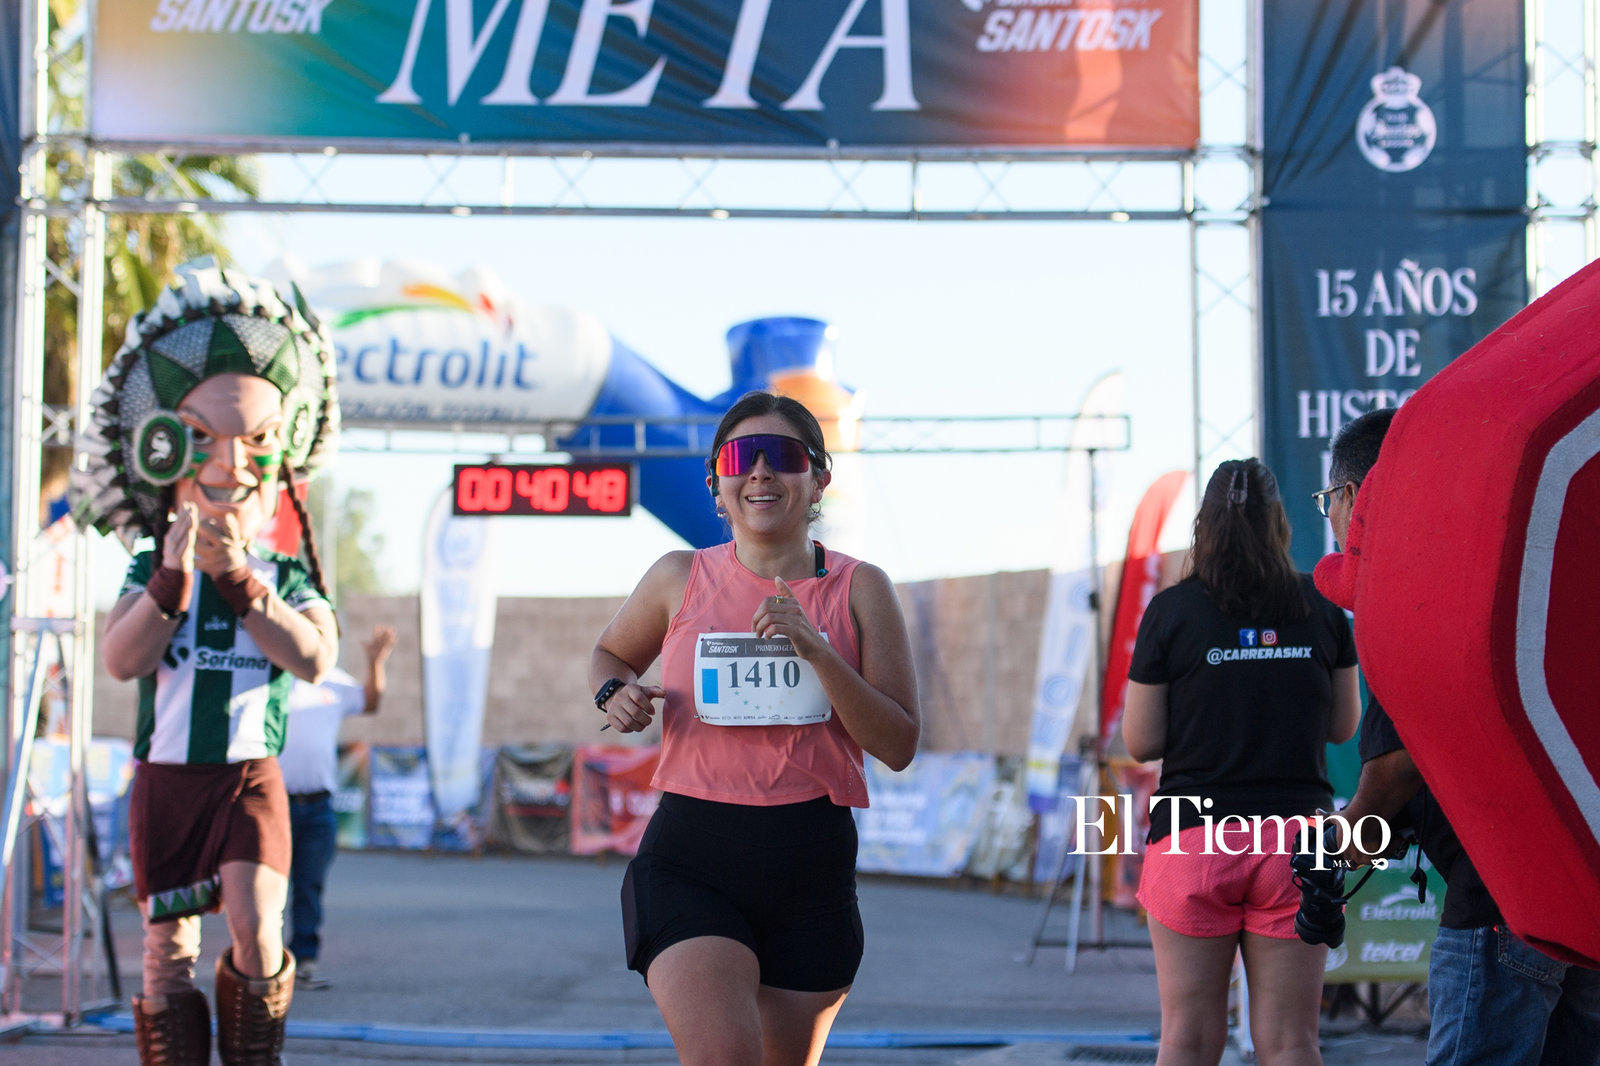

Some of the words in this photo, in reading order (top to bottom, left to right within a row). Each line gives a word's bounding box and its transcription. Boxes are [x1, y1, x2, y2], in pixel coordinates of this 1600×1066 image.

[150, 0, 333, 33] SANTOSK
[977, 8, 1163, 51] SANTOSK
[1316, 268, 1358, 317] 15
[1363, 258, 1478, 317] AÑOS
[1365, 328, 1422, 378] DE
[1298, 389, 1416, 438] HIST
[196, 650, 268, 670] Soriana
[708, 645, 739, 654] SANTOSK
[755, 644, 781, 652] PRIMERO
[1207, 646, 1312, 665] @CARRERASMX
[727, 660, 800, 688] 1410
[1361, 940, 1425, 962] telcel
